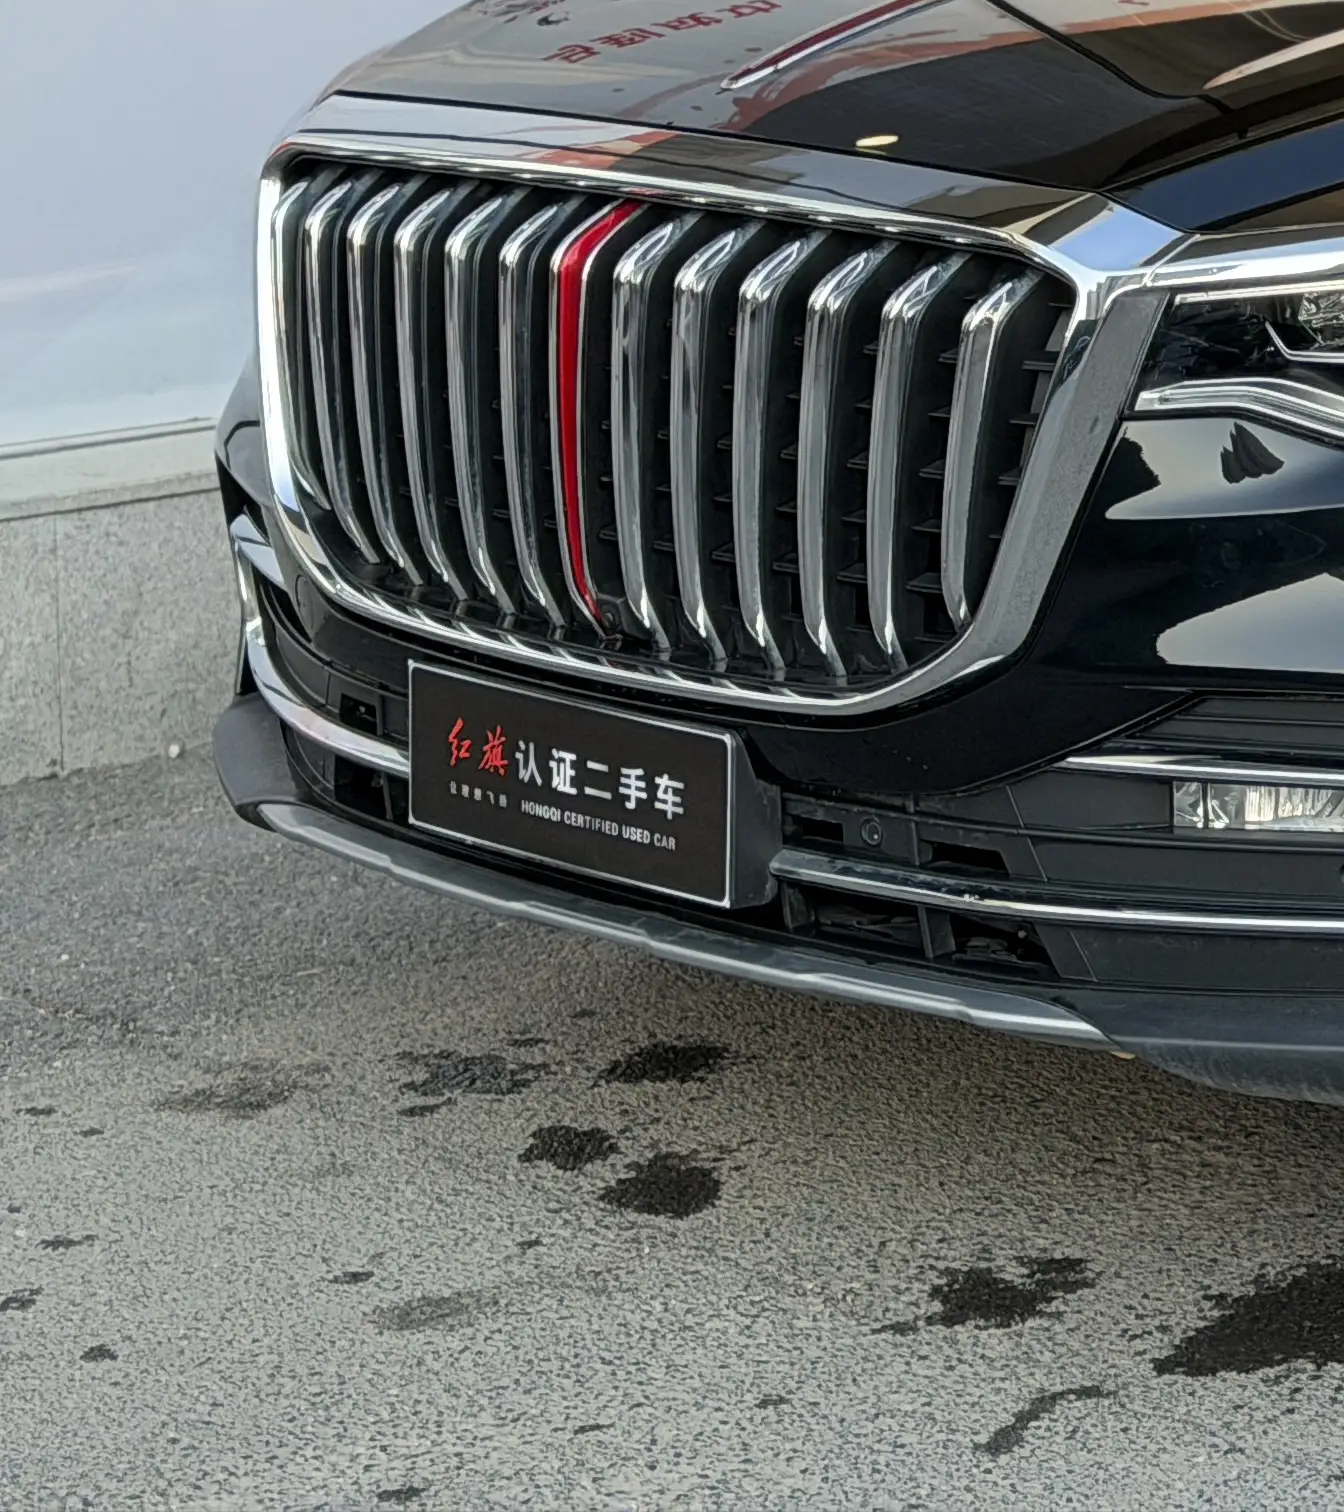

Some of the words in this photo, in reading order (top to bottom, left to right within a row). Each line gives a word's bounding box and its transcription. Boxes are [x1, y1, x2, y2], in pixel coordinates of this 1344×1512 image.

[520, 798, 562, 823] HONGQI
[563, 810, 619, 836] CERTIFIED
[621, 823, 651, 845] USED
[653, 832, 677, 851] CAR
